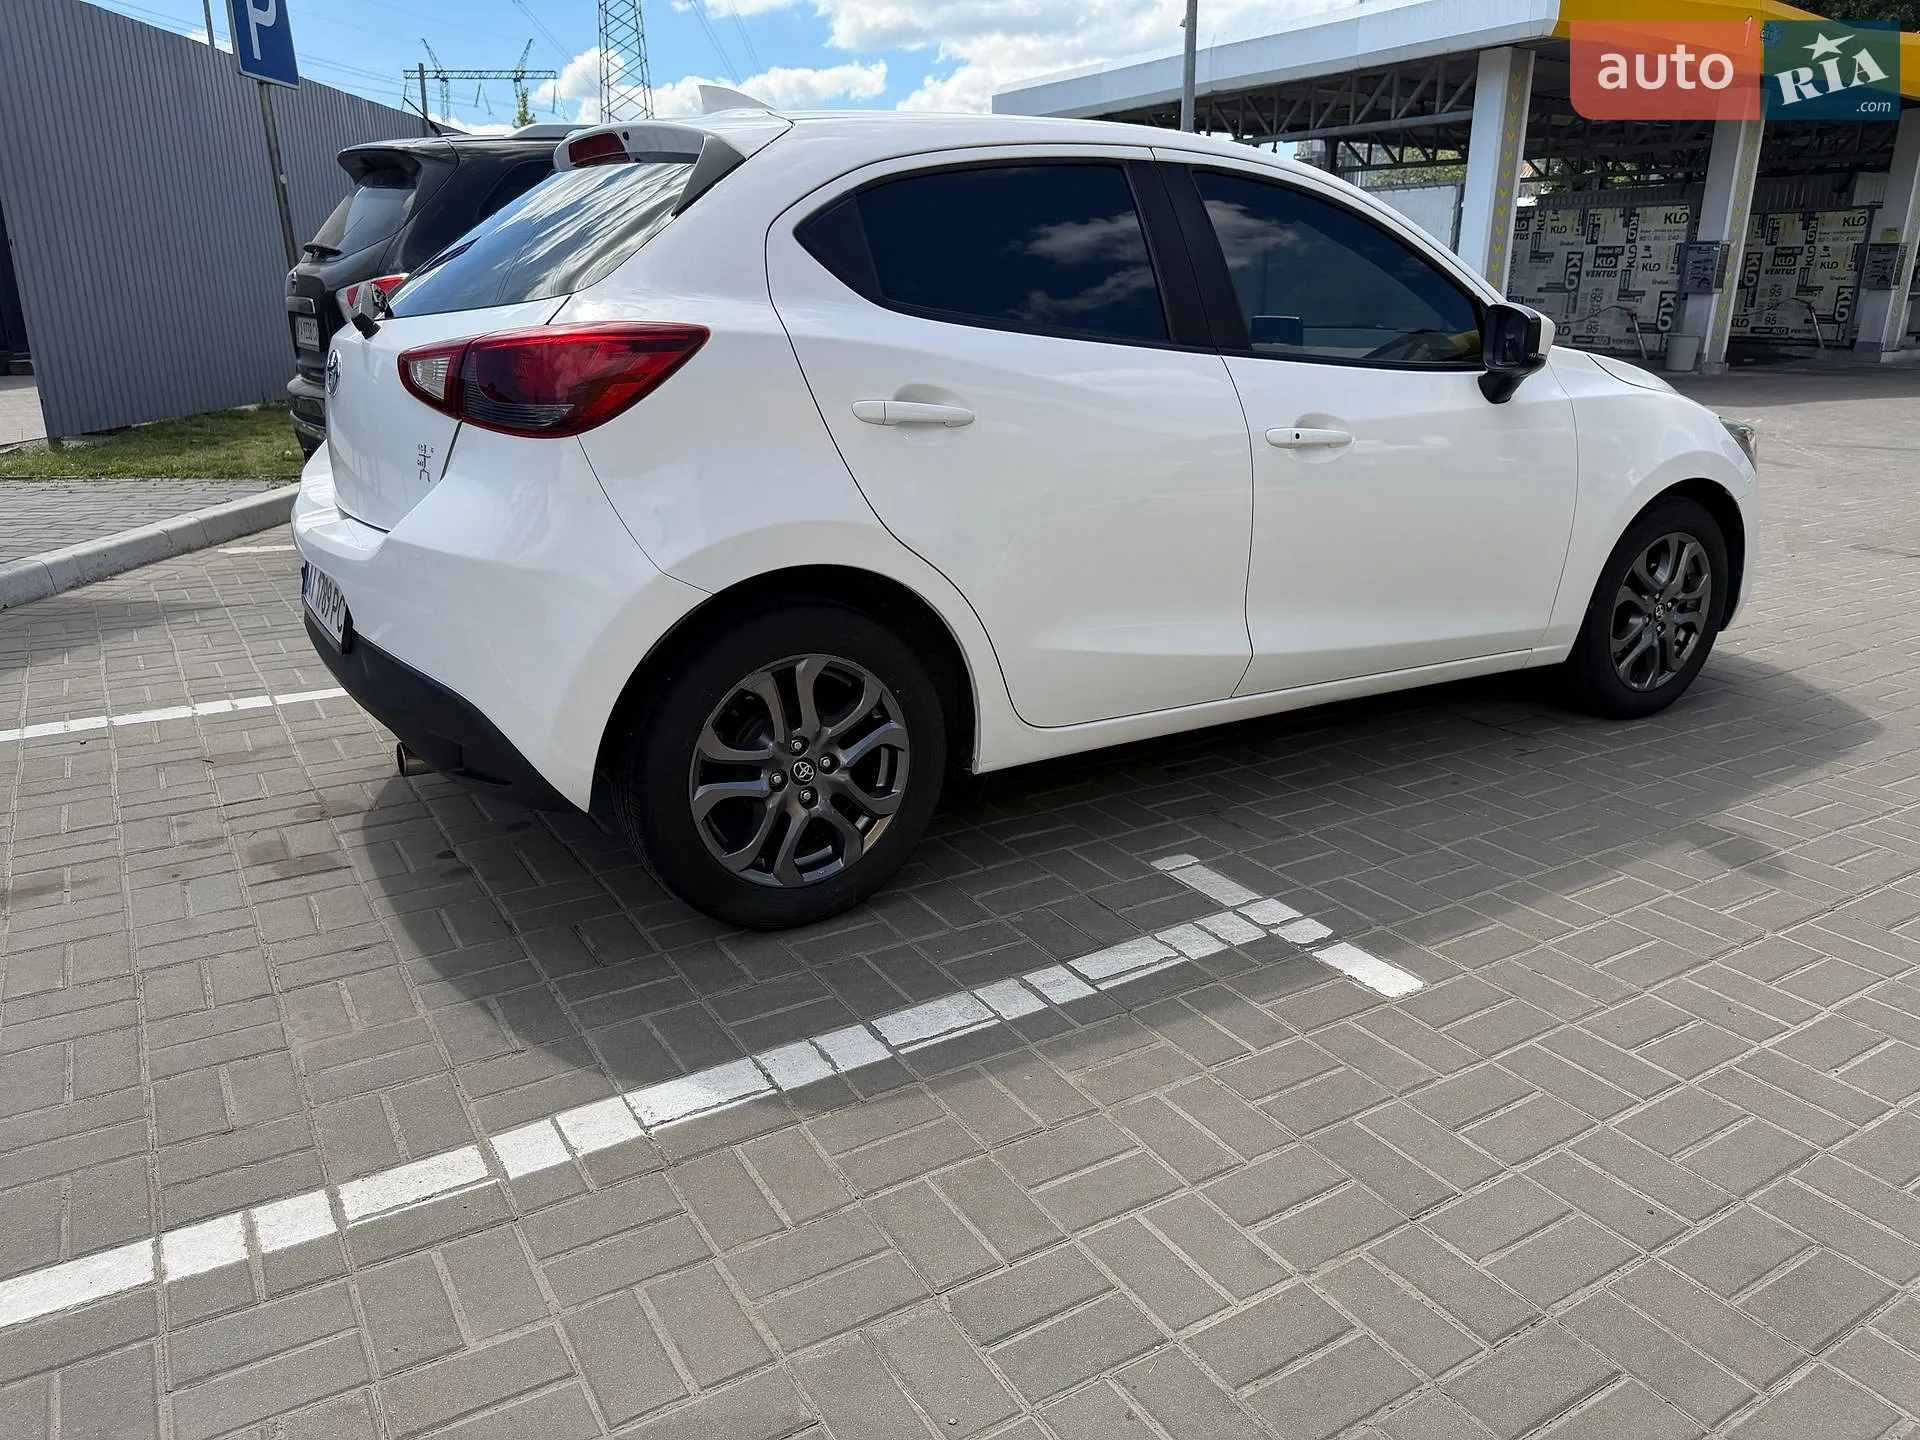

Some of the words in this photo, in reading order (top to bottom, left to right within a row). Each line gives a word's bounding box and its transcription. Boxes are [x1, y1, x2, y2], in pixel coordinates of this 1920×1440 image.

[246, 0, 277, 61] P
[1664, 213, 1689, 224] KLO
[1842, 216, 1867, 227] KLO
[1550, 225, 1567, 234] KLO
[1628, 216, 1638, 241] KLO
[1806, 219, 1817, 241] KLO
[1595, 257, 1617, 268] KLO
[1626, 245, 1637, 268] KLO
[1774, 255, 1795, 267] KLO
[1805, 245, 1815, 266] KLO
[1565, 253, 1582, 290] KLO
[1641, 263, 1661, 272] KLO
[1744, 253, 1761, 287] KLO
[1764, 268, 1796, 276] VENTUS
[1820, 261, 1839, 270] KLO
[1586, 270, 1618, 278] VENTUS
[1657, 292, 1677, 331] KLO
[330, 586, 346, 633] PC
